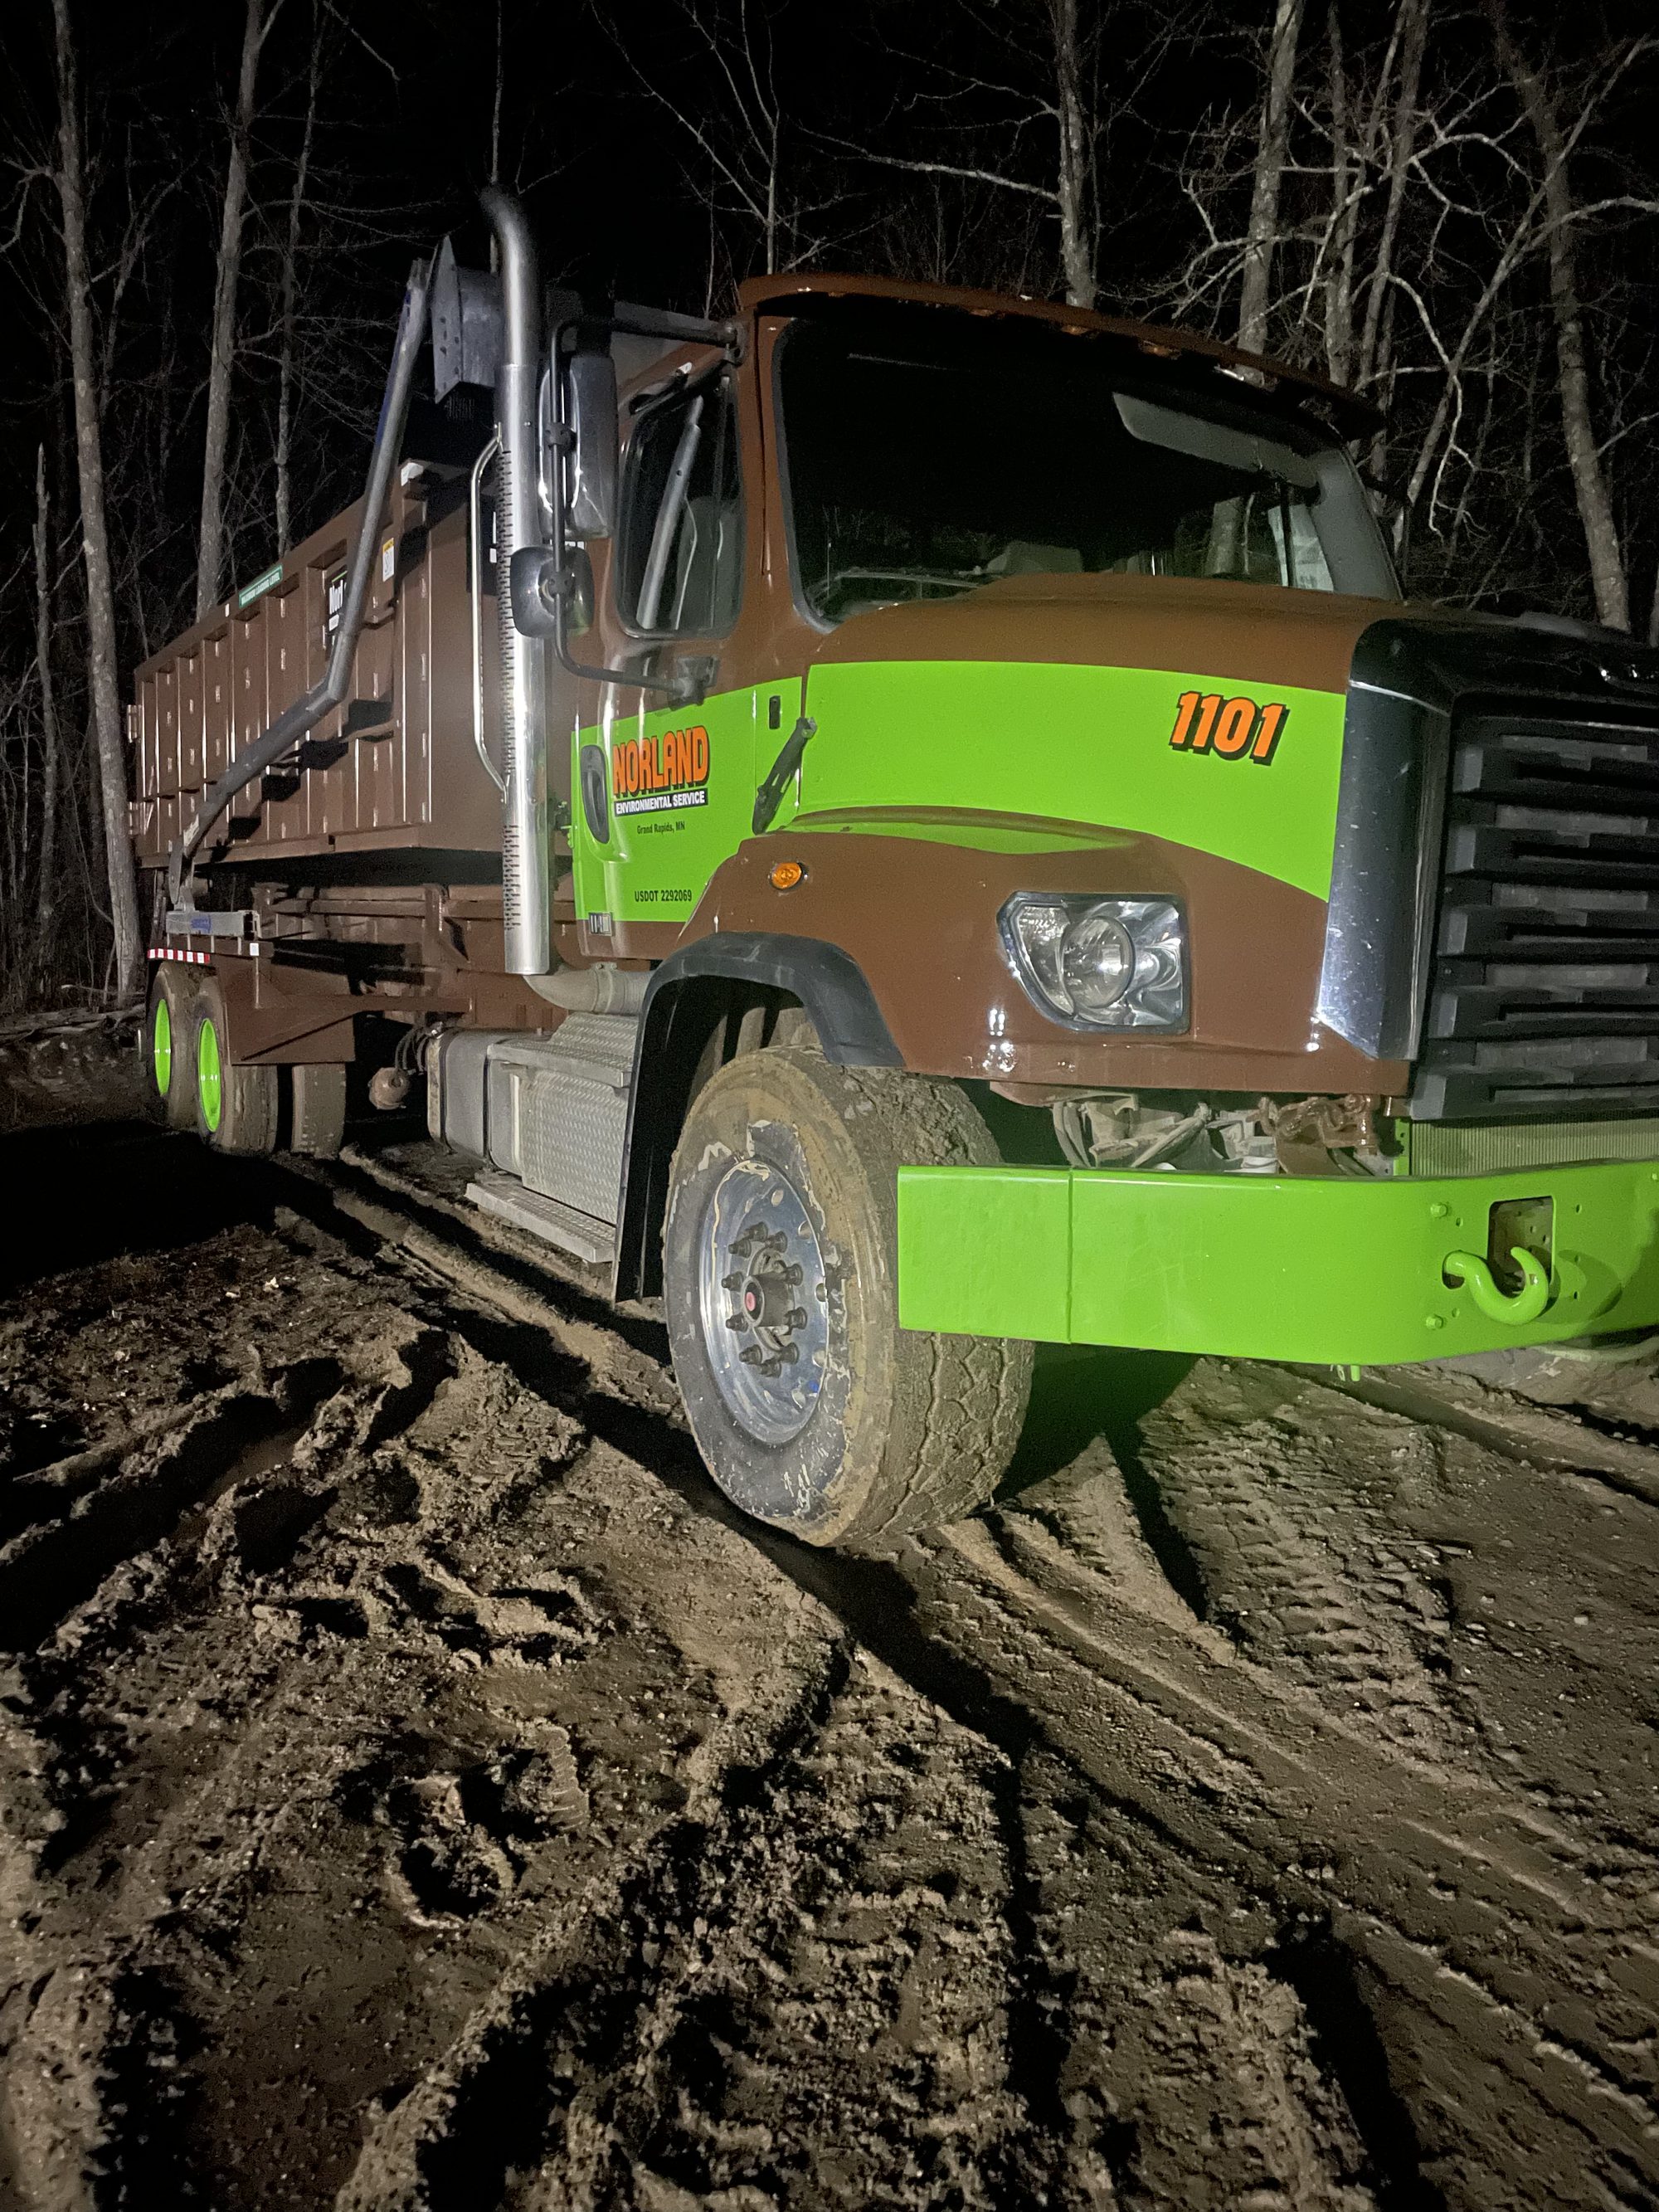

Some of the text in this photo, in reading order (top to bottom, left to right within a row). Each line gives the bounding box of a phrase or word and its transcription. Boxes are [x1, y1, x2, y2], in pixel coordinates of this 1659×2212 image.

[1170, 691, 1289, 765] 1101
[613, 725, 711, 796] NORLAND
[615, 791, 705, 815] ENVIRONMENTAL SERVICE
[637, 824, 653, 835] Grand
[675, 821, 685, 831] MN
[635, 889, 693, 902] USDOT 2292069
